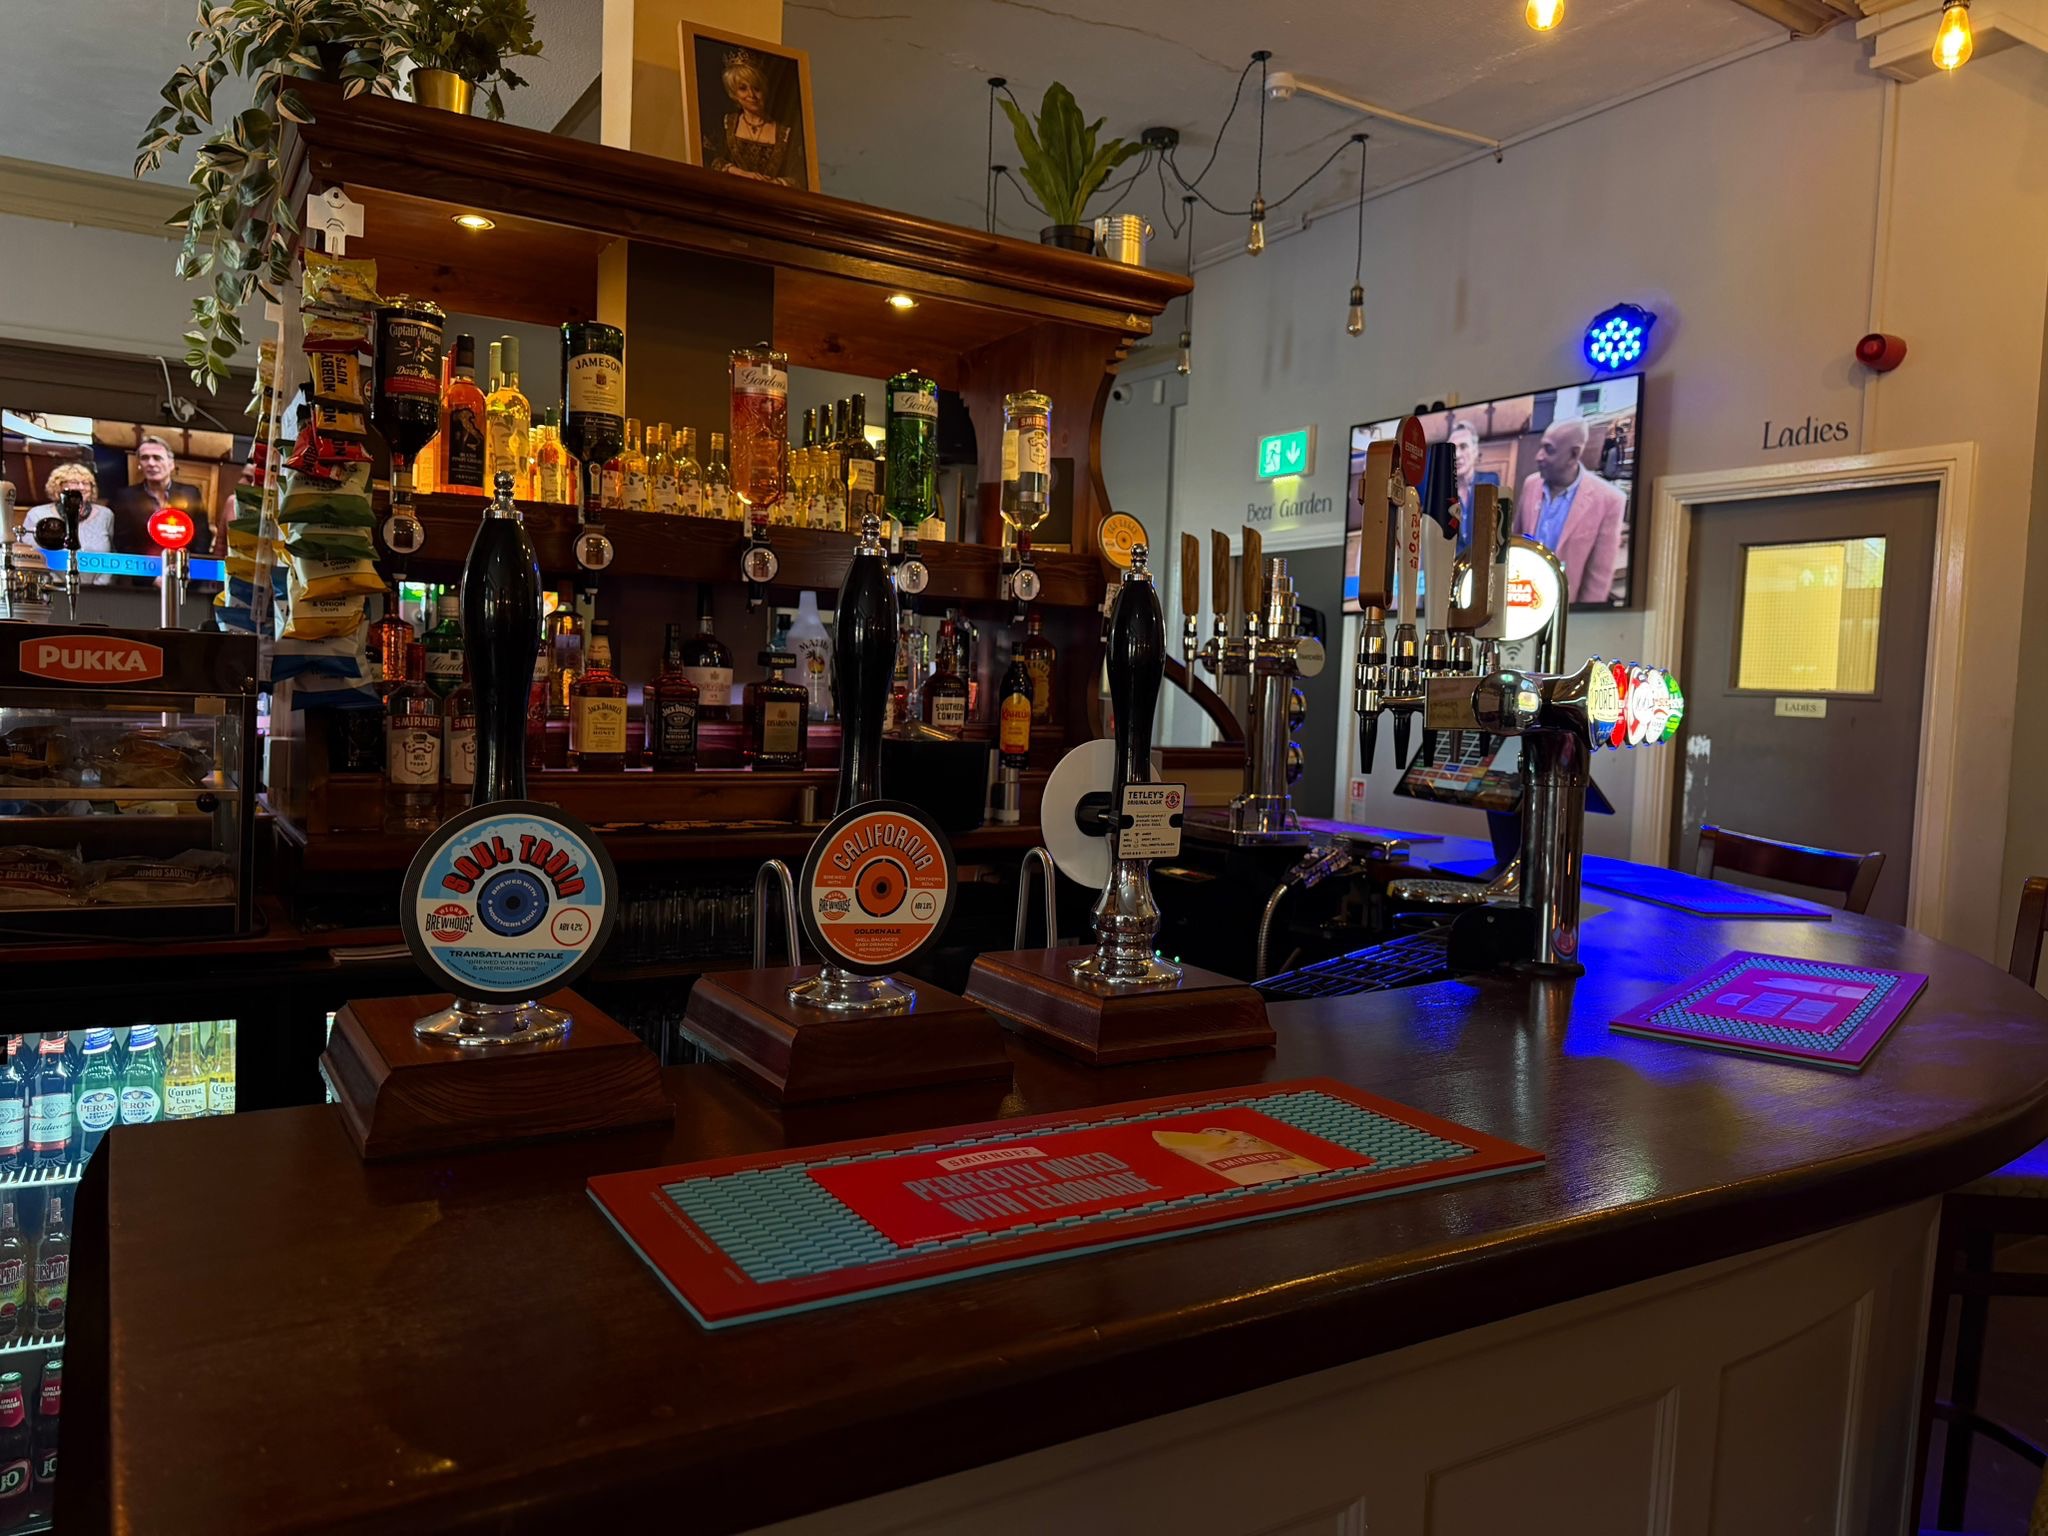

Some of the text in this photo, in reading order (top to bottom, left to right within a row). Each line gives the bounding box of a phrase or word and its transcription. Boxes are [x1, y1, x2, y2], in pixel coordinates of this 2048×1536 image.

[389, 322, 418, 337] Captain
[321, 353, 336, 392] NOBBY
[336, 357, 347, 385] NUTS
[575, 358, 621, 374] JAMESON
[1762, 416, 1848, 450] Ladies
[1247, 491, 1332, 522] Beer Garden
[79, 556, 157, 572] SOLD £110
[38, 645, 148, 672] PUKKA
[1128, 791, 1164, 799] TETLEY'S
[832, 823, 934, 872] CALIFORNIA
[442, 834, 585, 900] SOUL TRAIN
[491, 879, 538, 897] BREWED WITH
[425, 913, 475, 932] BREWHOUSE
[488, 906, 537, 927] NORTHERN SOUL
[559, 923, 583, 932] ABV 4.2%
[449, 950, 535, 959] TRANSATLANTIC
[168, 1086, 202, 1098] Corona
[947, 1148, 1032, 1168] SMIRNOFF
[1214, 1152, 1281, 1170] SMIRNOFF
[901, 1151, 1130, 1201] PERFECTLY MIXED
[939, 1171, 1164, 1222] WITH LEMONADE
